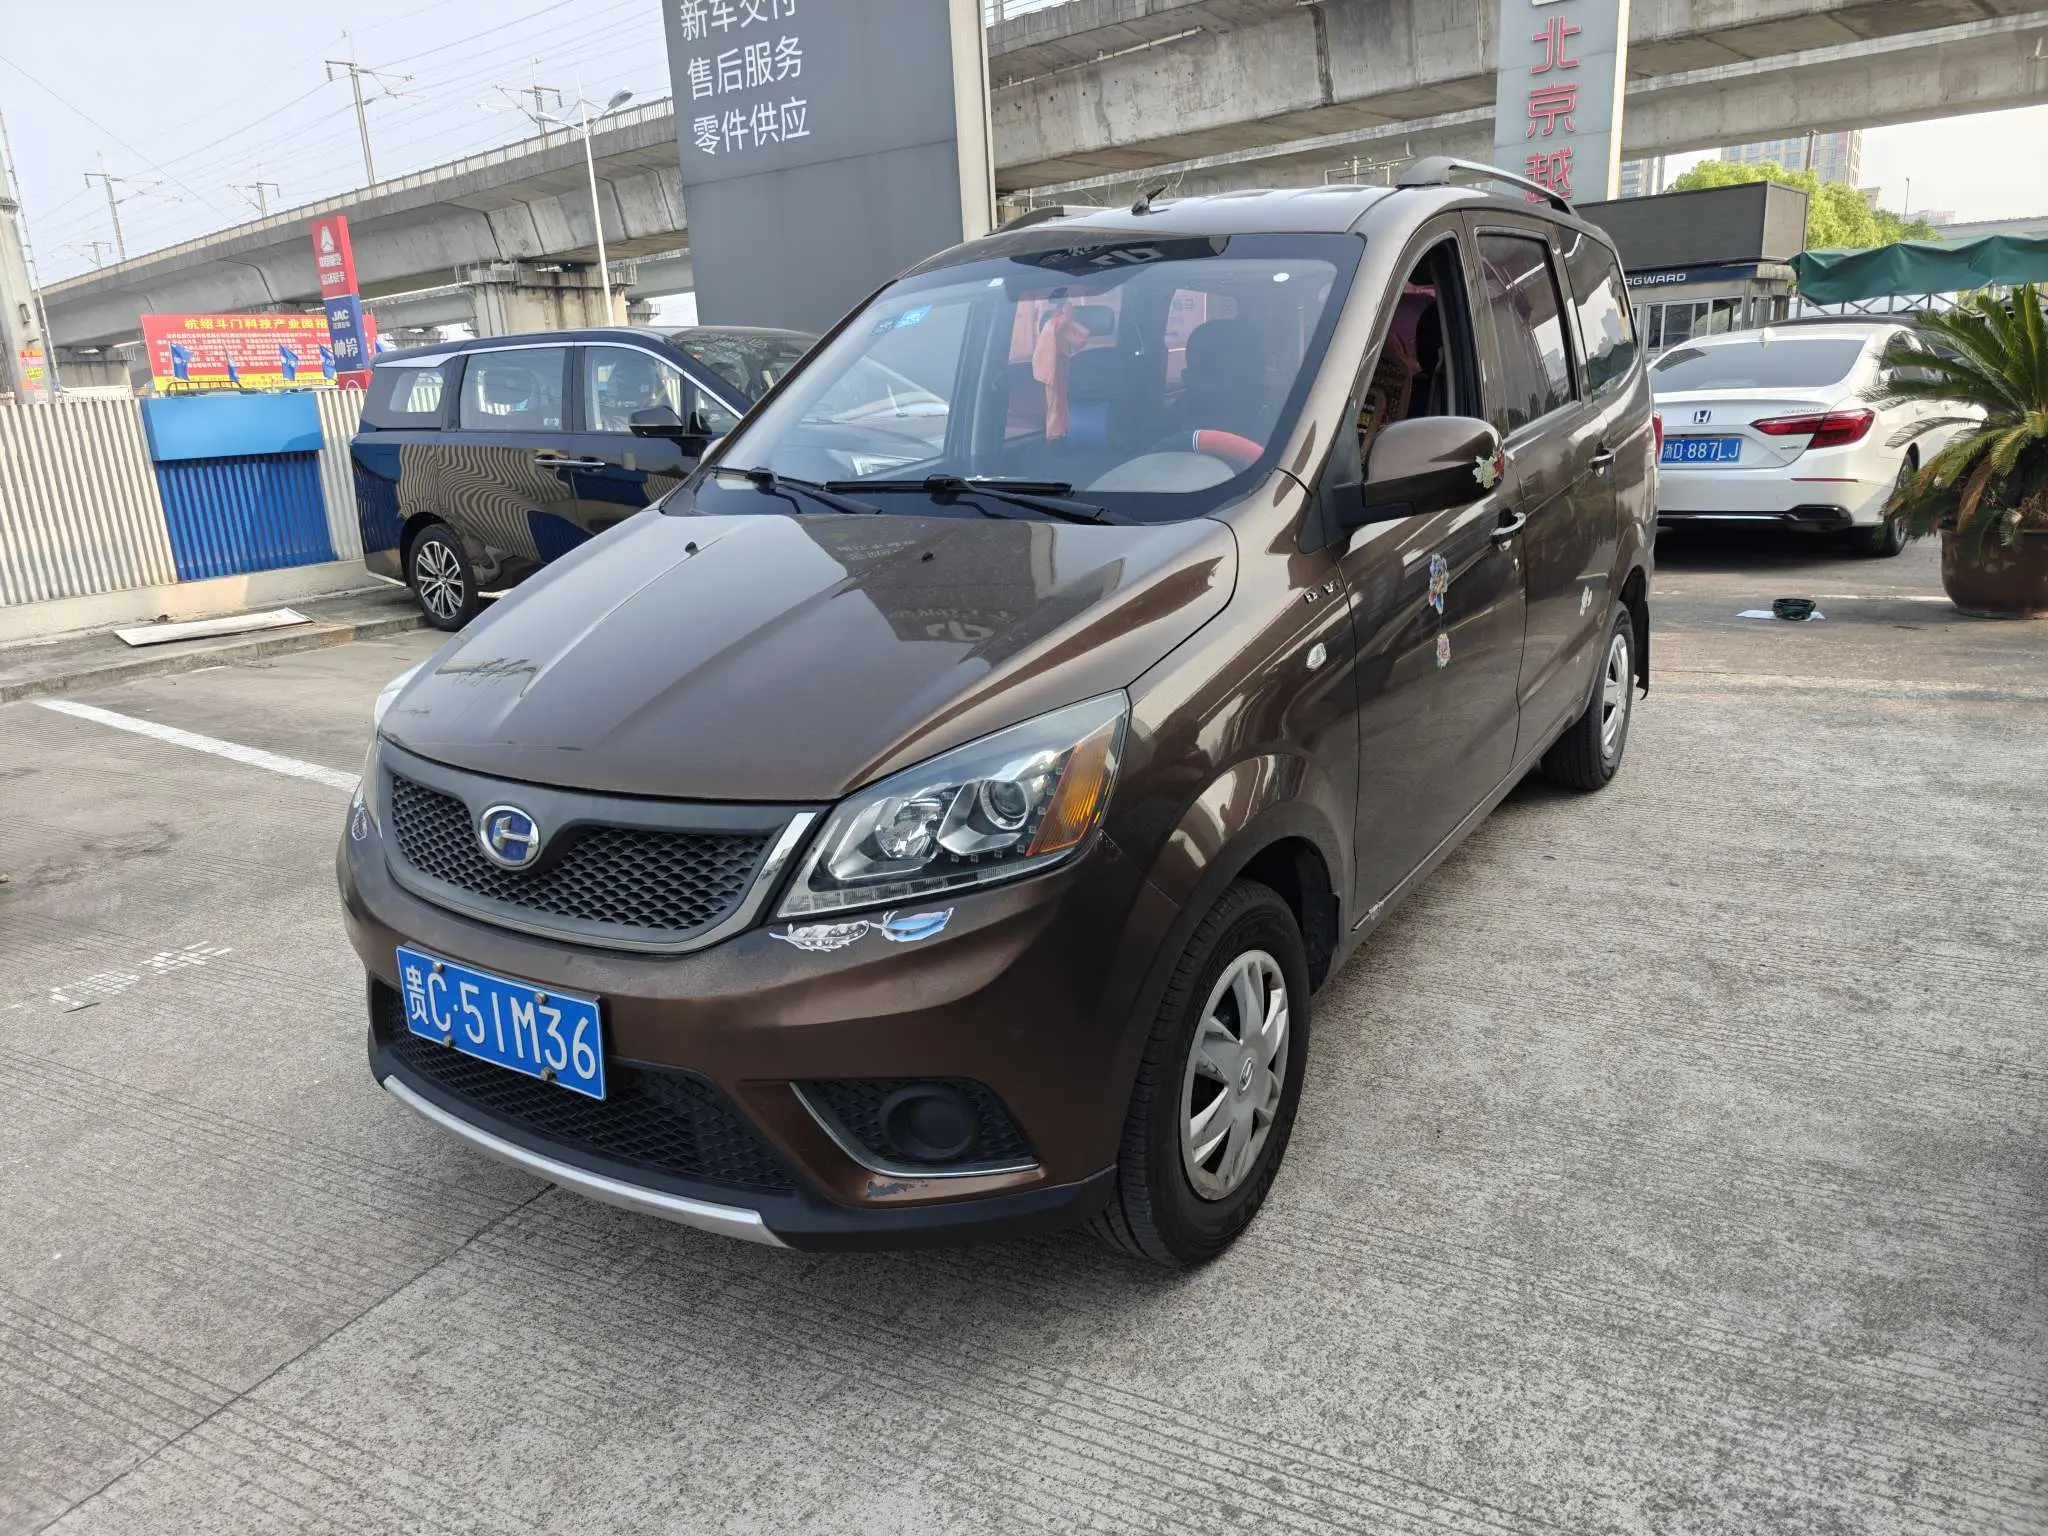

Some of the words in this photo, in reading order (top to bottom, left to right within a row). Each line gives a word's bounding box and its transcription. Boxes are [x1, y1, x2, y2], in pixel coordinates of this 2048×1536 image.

[687, 35, 803, 100] 售后服务
[693, 96, 810, 155] 零件供应
[332, 309, 350, 322] JAC
